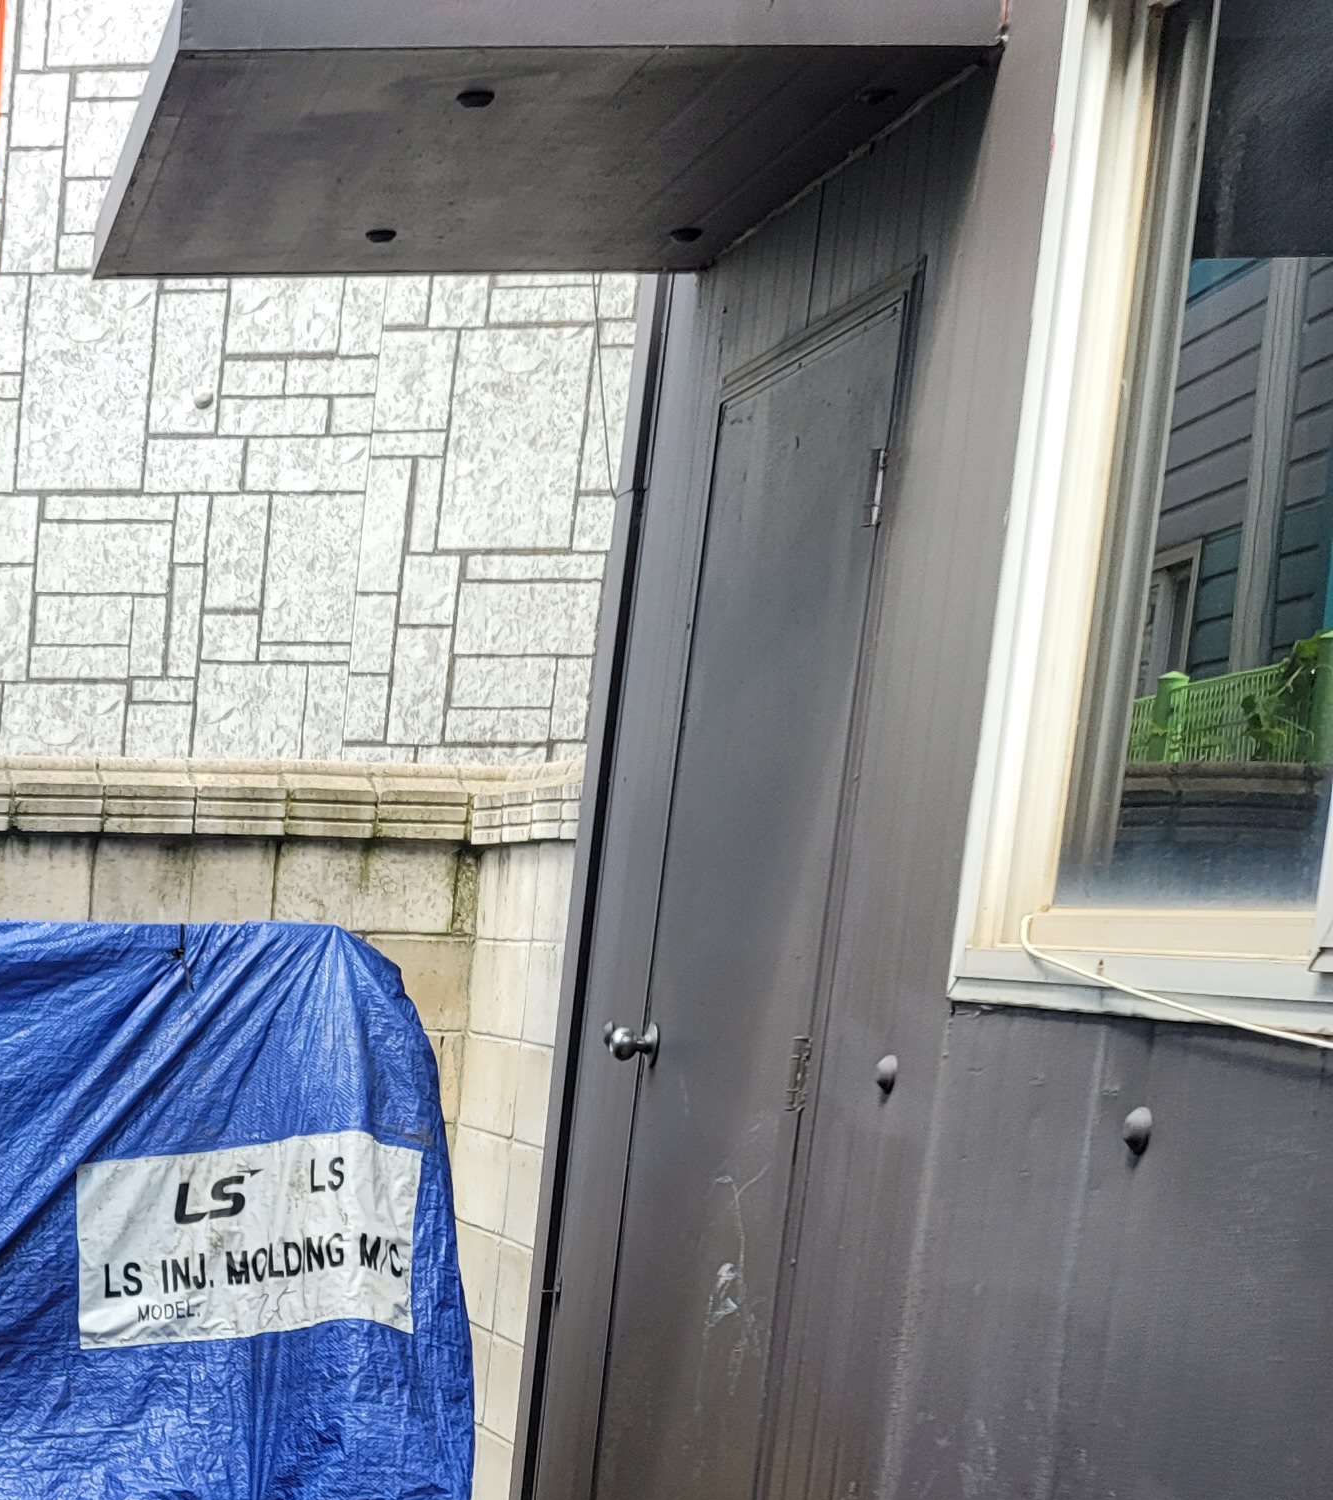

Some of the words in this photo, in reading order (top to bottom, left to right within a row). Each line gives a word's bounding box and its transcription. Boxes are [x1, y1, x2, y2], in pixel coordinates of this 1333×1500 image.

[310, 1156, 345, 1193] LS
[174, 1175, 246, 1225] LS
[103, 1262, 143, 1298] LS
[160, 1252, 215, 1294] INJ.
[359, 1232, 404, 1278] M/C
